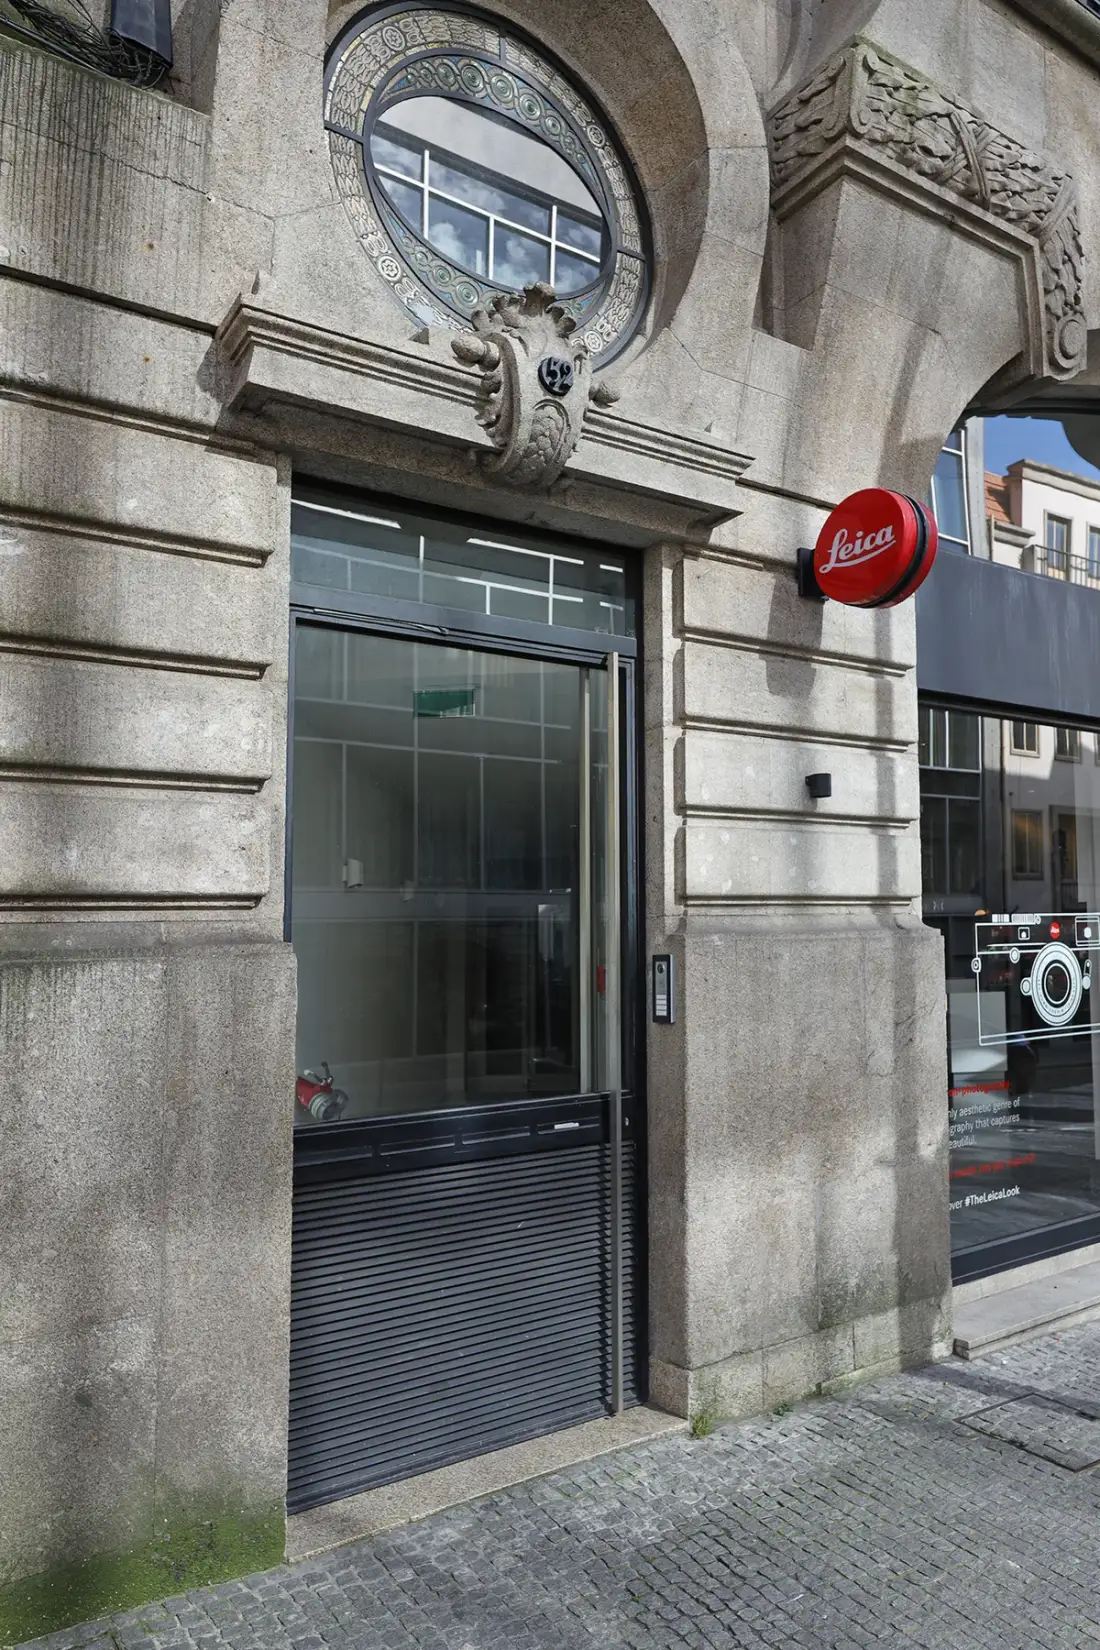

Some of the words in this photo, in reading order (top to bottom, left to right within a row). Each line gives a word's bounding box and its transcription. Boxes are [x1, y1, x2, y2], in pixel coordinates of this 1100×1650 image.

[544, 357, 573, 392] 52
[819, 525, 896, 574] Leica
[959, 1103, 991, 1117] aesthetic
[992, 1099, 1012, 1113] genre
[1013, 1096, 1021, 1107] of
[975, 1117, 990, 1129] that
[990, 1113, 1020, 1128] captures
[964, 1185, 1021, 1207] #TheLeicaLook
